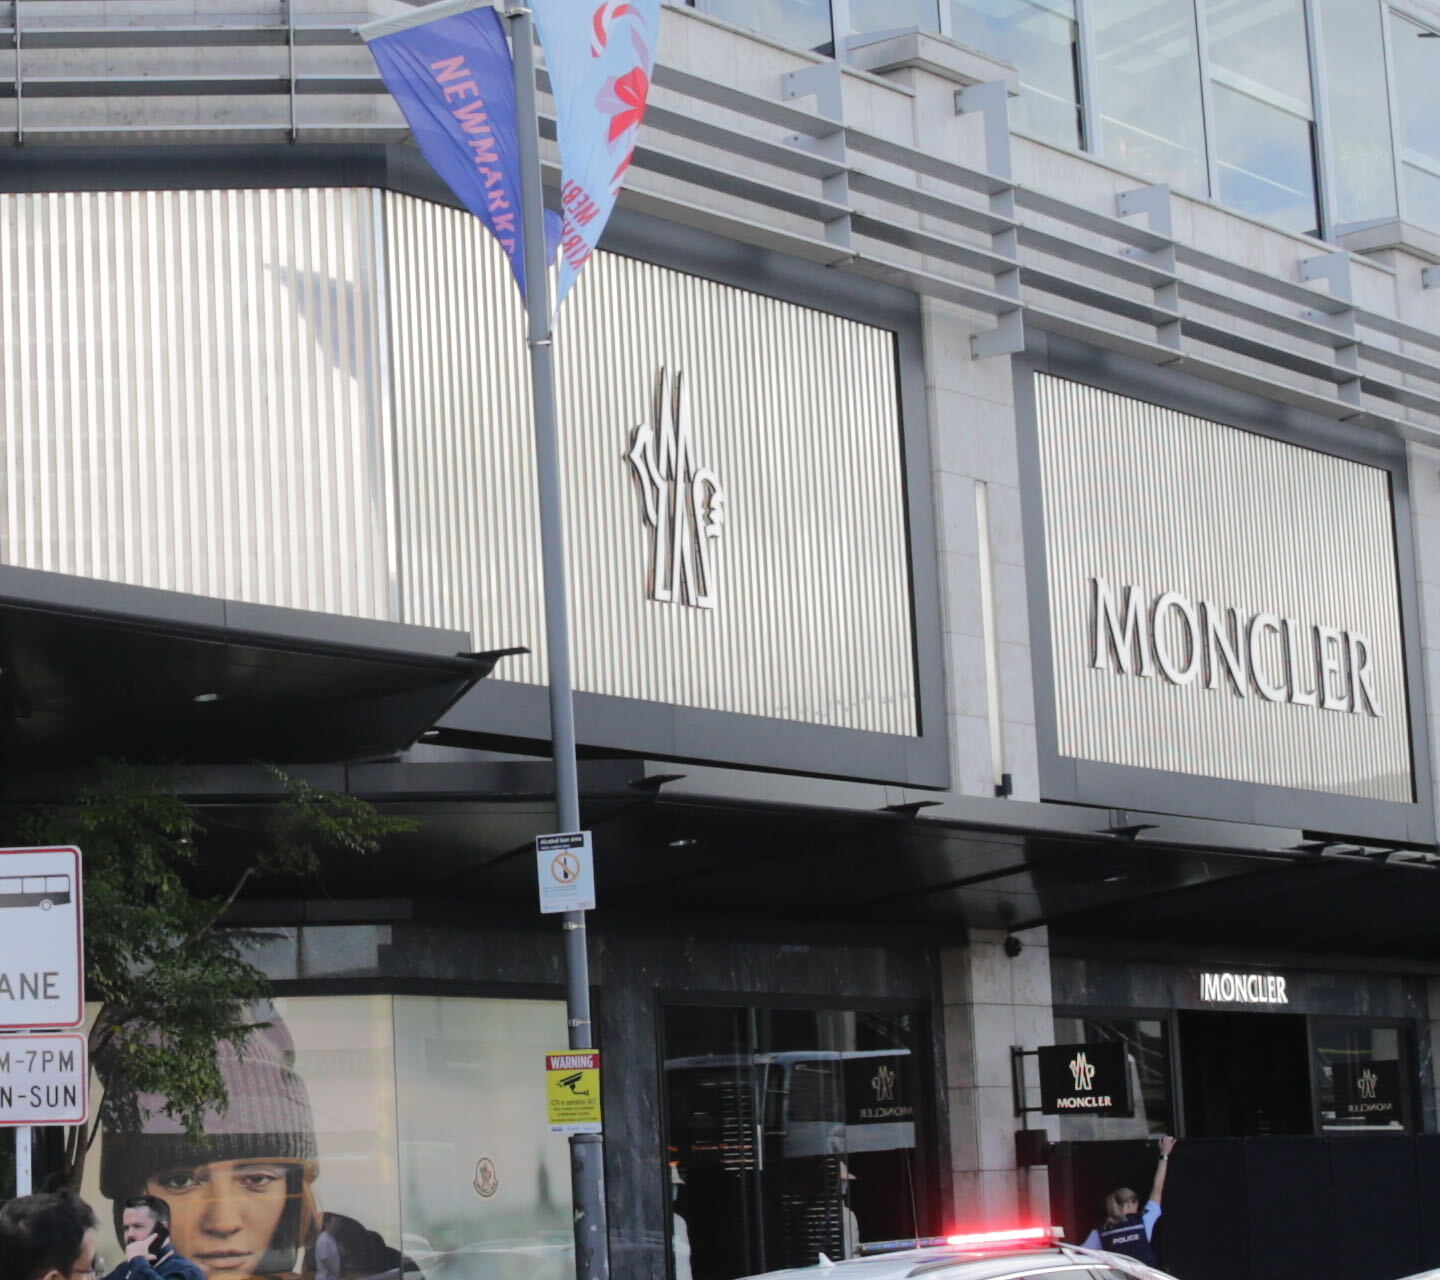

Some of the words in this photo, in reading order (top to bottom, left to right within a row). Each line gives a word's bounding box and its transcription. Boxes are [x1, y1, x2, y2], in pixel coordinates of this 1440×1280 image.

[1090, 576, 1384, 718] MONCLER
[1201, 972, 1289, 1004] MONCLER
[550, 1054, 594, 1070] WARNING
[1056, 1096, 1113, 1109] MONCLER
[1112, 1233, 1140, 1245] POLICE
